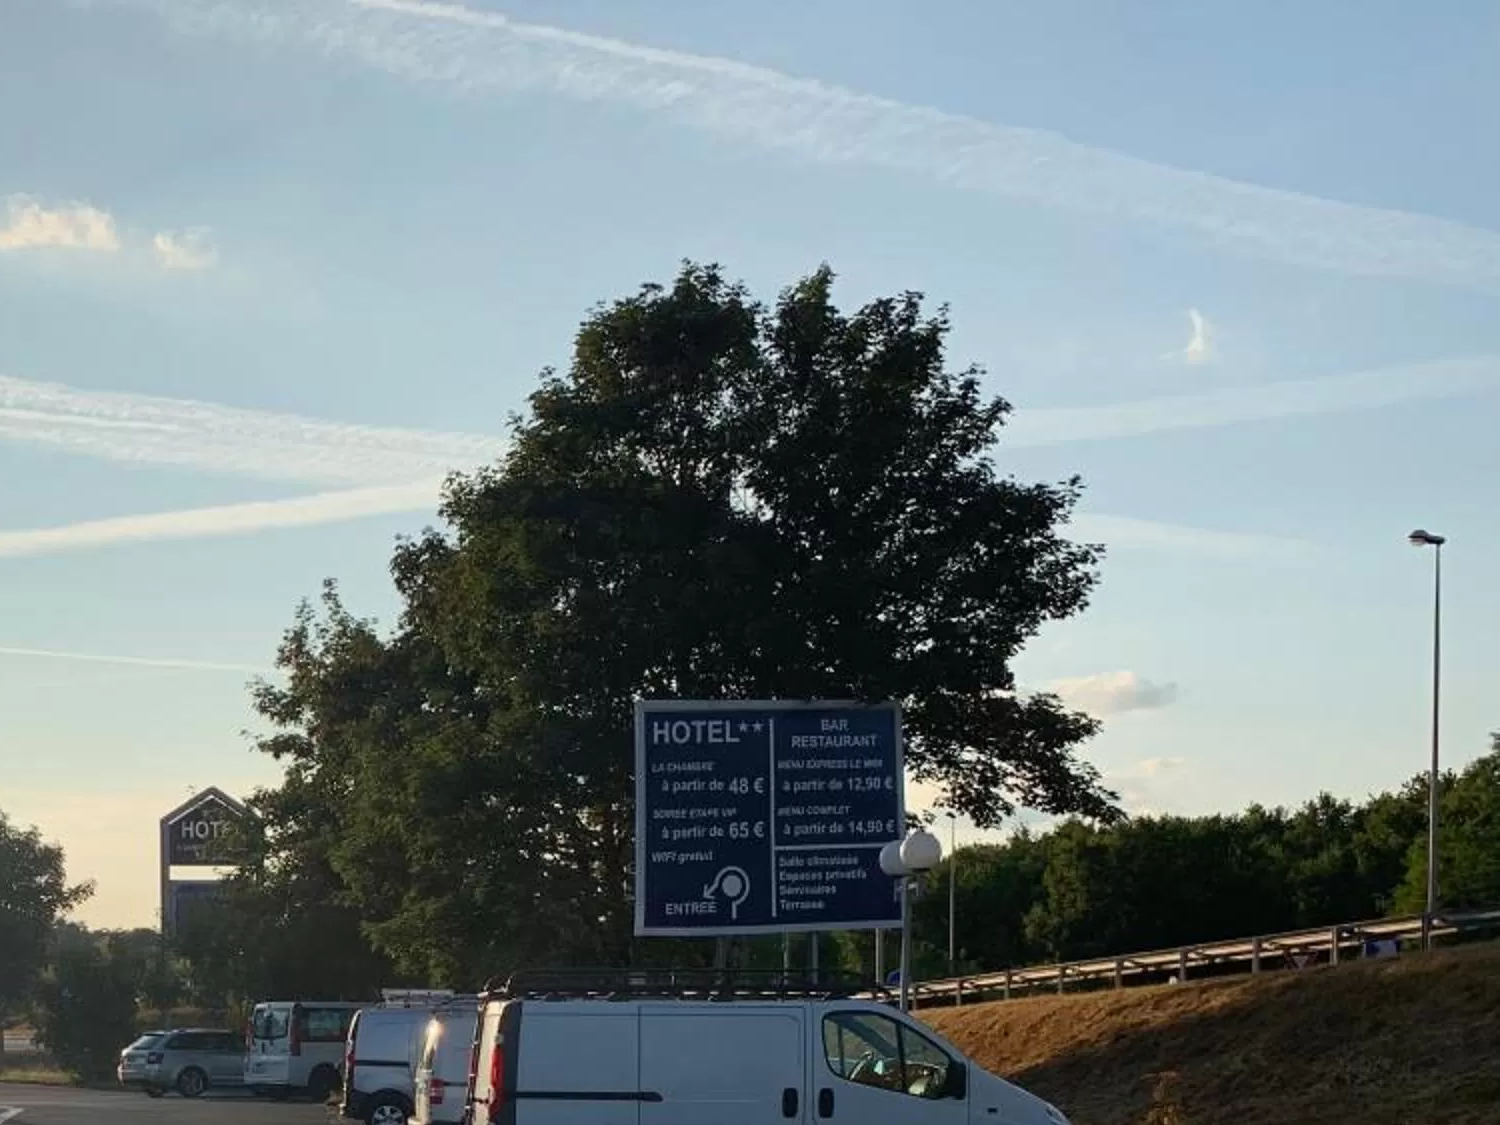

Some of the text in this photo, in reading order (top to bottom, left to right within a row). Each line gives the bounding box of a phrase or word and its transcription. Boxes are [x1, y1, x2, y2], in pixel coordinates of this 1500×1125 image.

[821, 719, 849, 731] BAR
[791, 734, 877, 748] RESTAURANT
[661, 777, 765, 794] à partir de 48 €
[782, 776, 893, 795] à partir de 12,90 €
[661, 821, 765, 840] à partir de 65 €
[783, 819, 895, 836] à partir de 14,90 €
